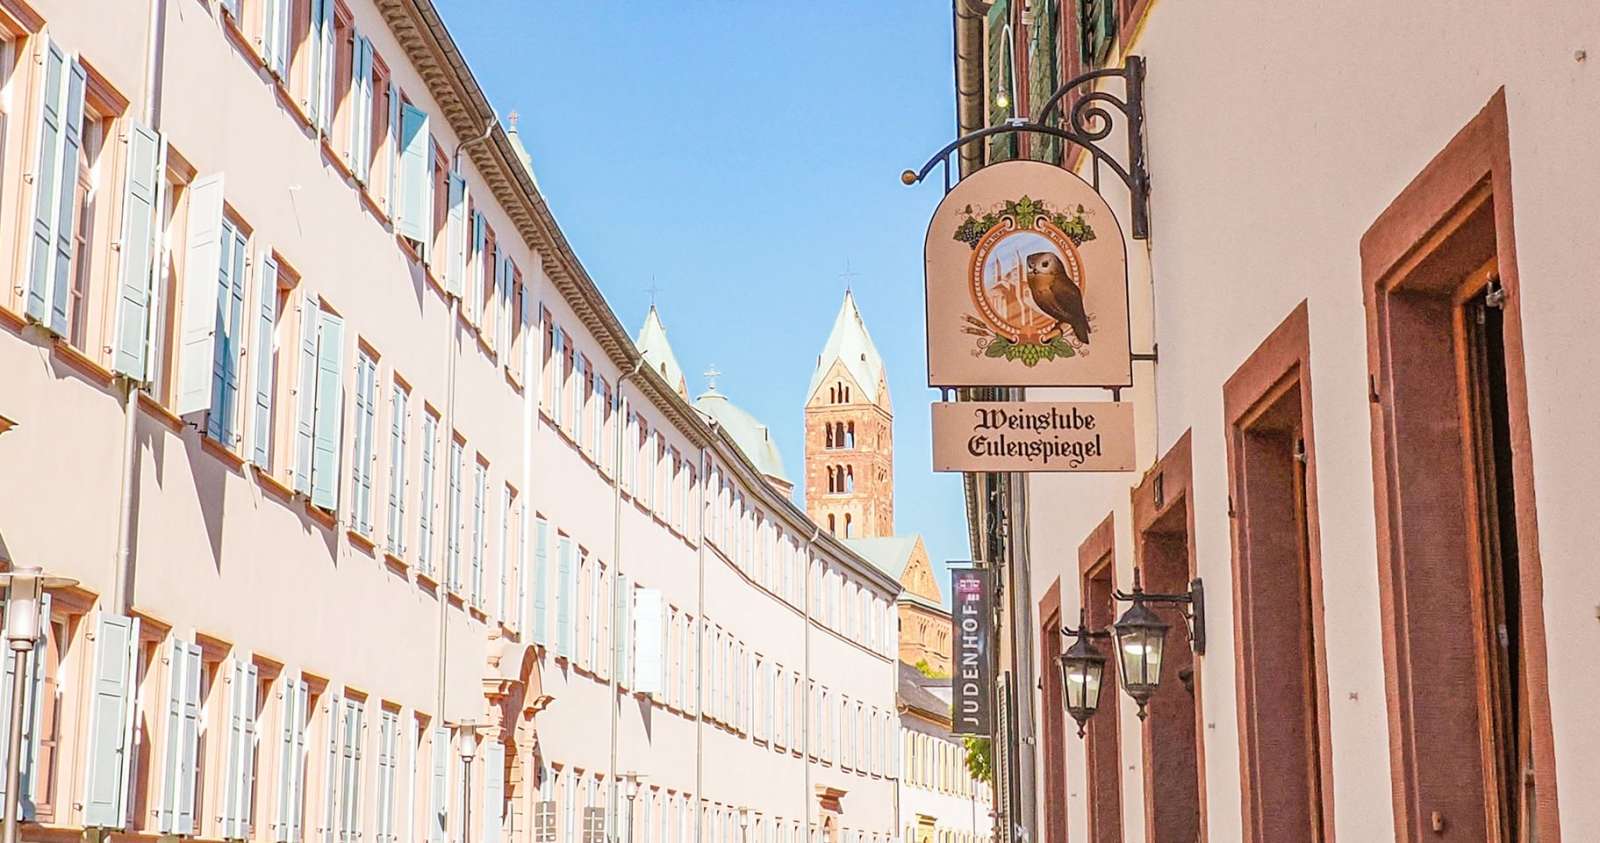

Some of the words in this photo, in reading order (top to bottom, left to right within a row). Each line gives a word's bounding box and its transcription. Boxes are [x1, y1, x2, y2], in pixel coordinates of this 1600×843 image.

[974, 408, 1095, 436] Weinstube
[967, 435, 1102, 468] Eulenspiegel
[962, 605, 979, 726] JUDENHOF
